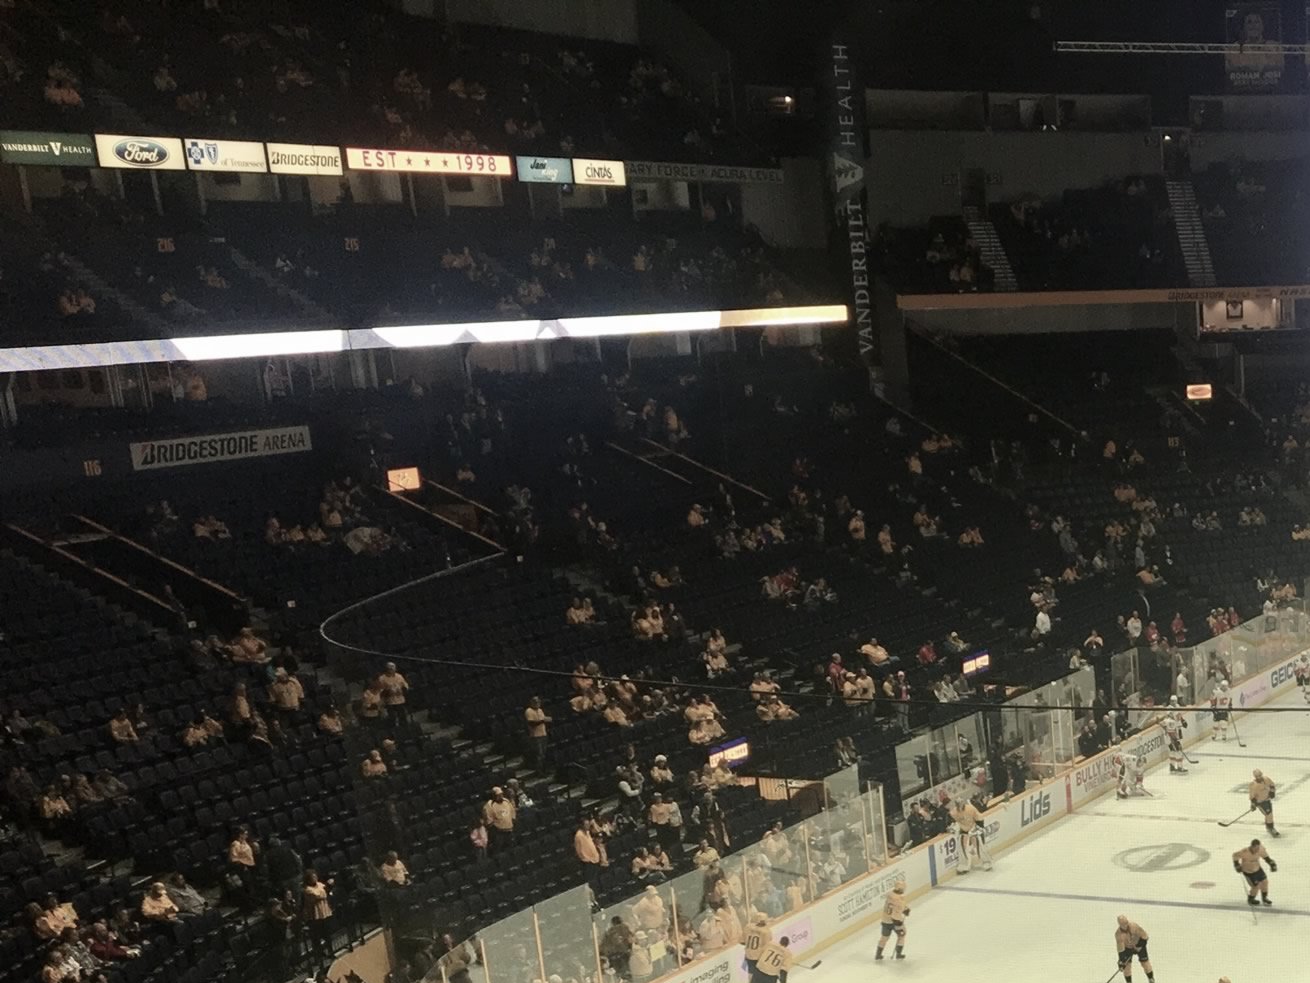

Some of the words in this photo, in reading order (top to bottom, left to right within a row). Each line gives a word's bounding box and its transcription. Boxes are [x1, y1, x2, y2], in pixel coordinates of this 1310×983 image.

[832, 45, 857, 146] HEALTH
[2, 142, 49, 153] VANDERBILT
[63, 146, 92, 155] HEALTH
[124, 141, 160, 163] Ford
[271, 151, 339, 167] BRIDGESTONE
[362, 150, 397, 168] EST
[456, 155, 497, 172] 1998
[847, 199, 875, 356] VANDERBILT
[141, 436, 258, 465] BRIDGESTONE
[263, 432, 306, 450] ARENA
[1075, 762, 1101, 787] BULLY
[1020, 790, 1051, 828] Lids
[837, 896, 854, 917] SCOTT
[855, 885, 880, 908] HAMILTON
[746, 935, 760, 951] 10
[791, 930, 809, 943] Group
[763, 950, 783, 967] 76
